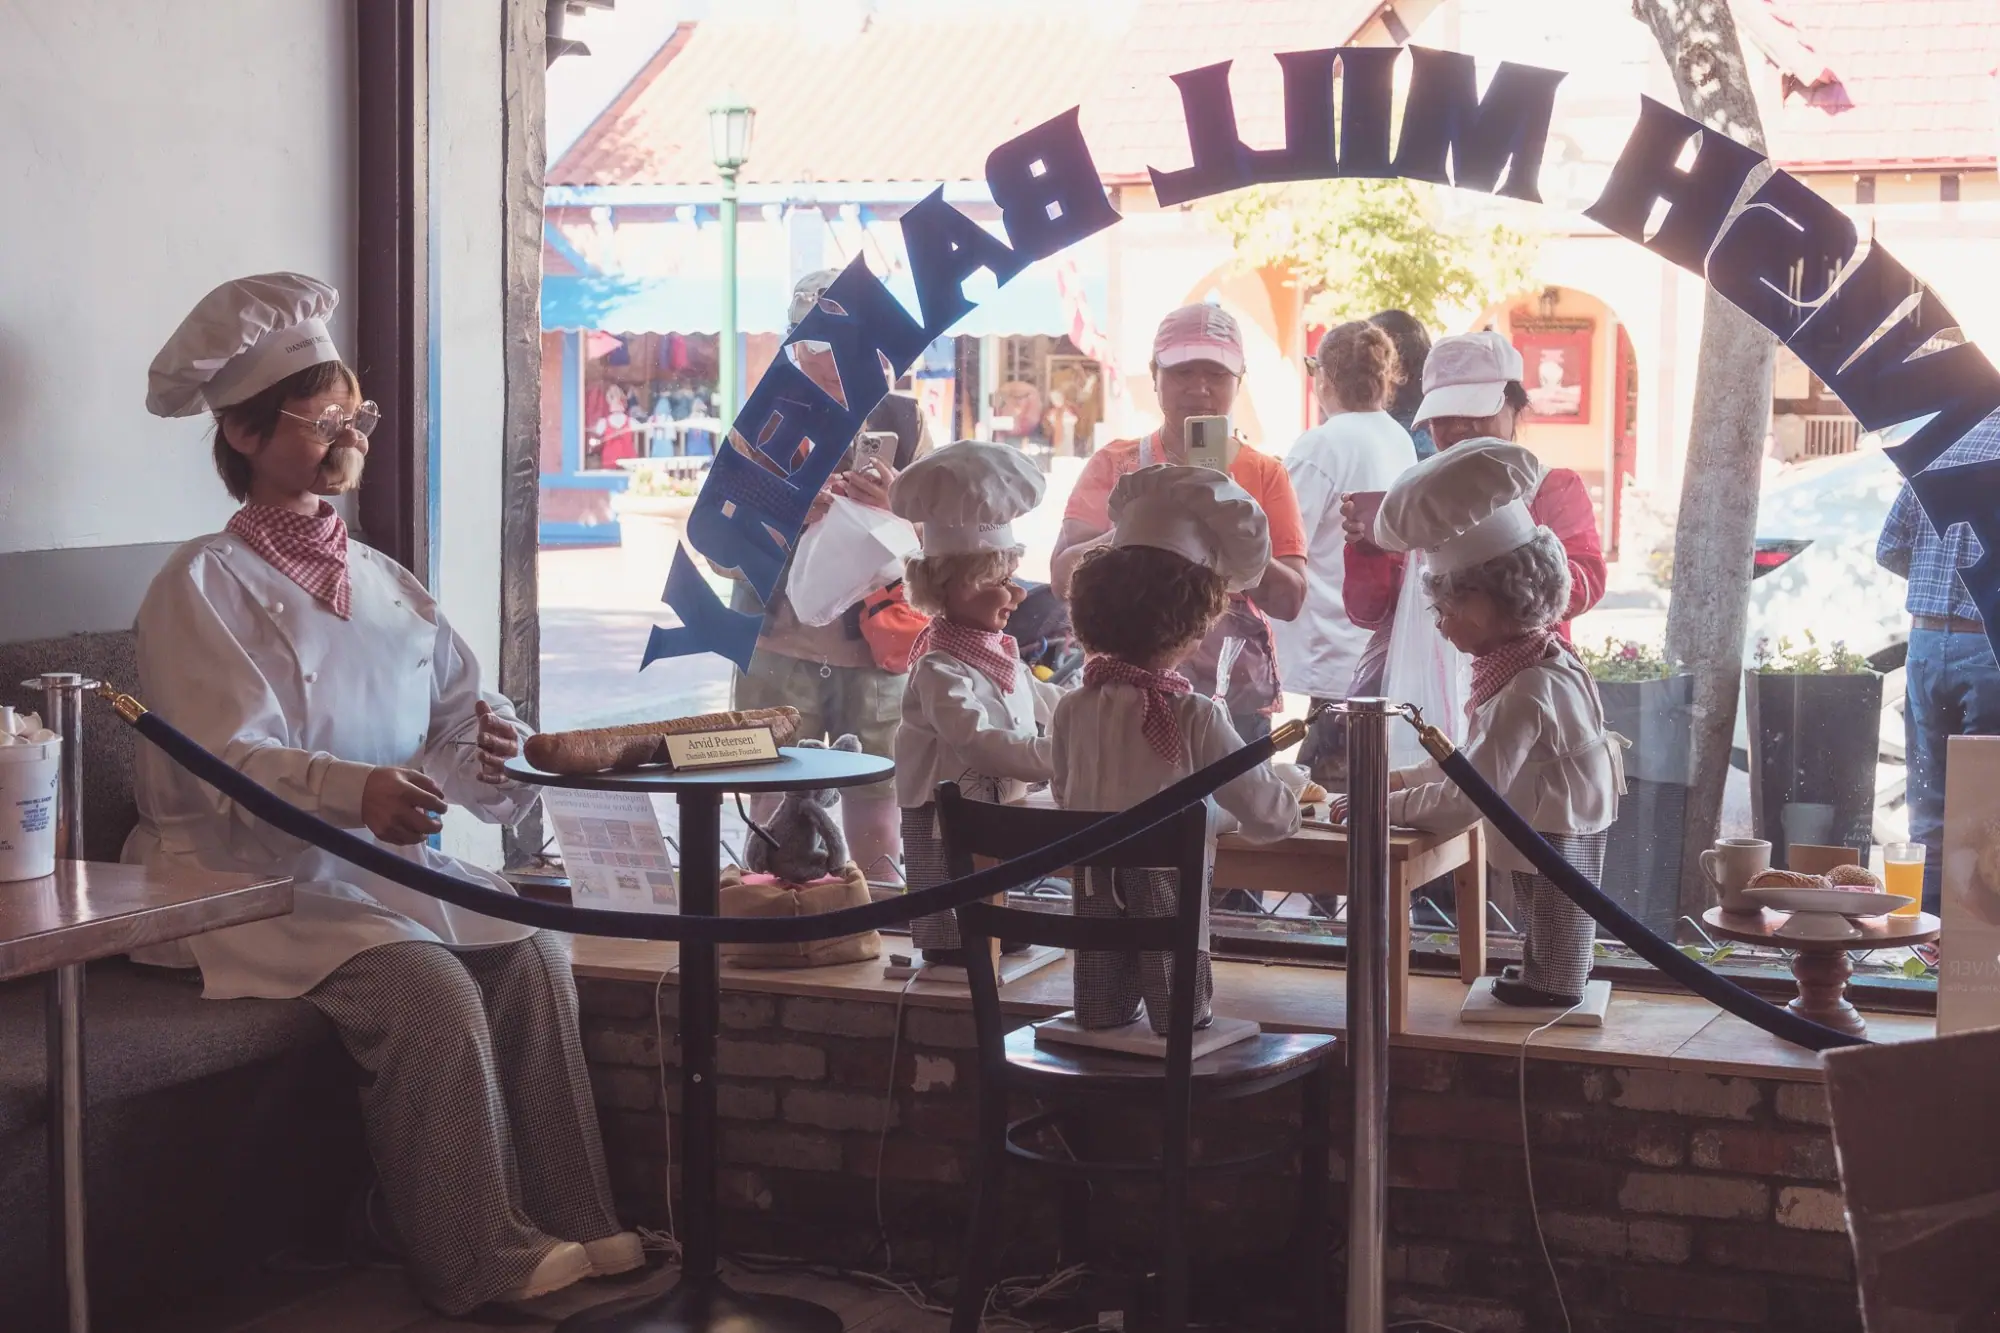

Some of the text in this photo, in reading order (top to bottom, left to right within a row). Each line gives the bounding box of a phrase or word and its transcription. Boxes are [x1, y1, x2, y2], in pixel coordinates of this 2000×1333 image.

[285, 337, 314, 353] DANISH
[688, 735, 754, 750] Arvid Petersen
[685, 747, 762, 761] Danish Mill Bakery Founder
